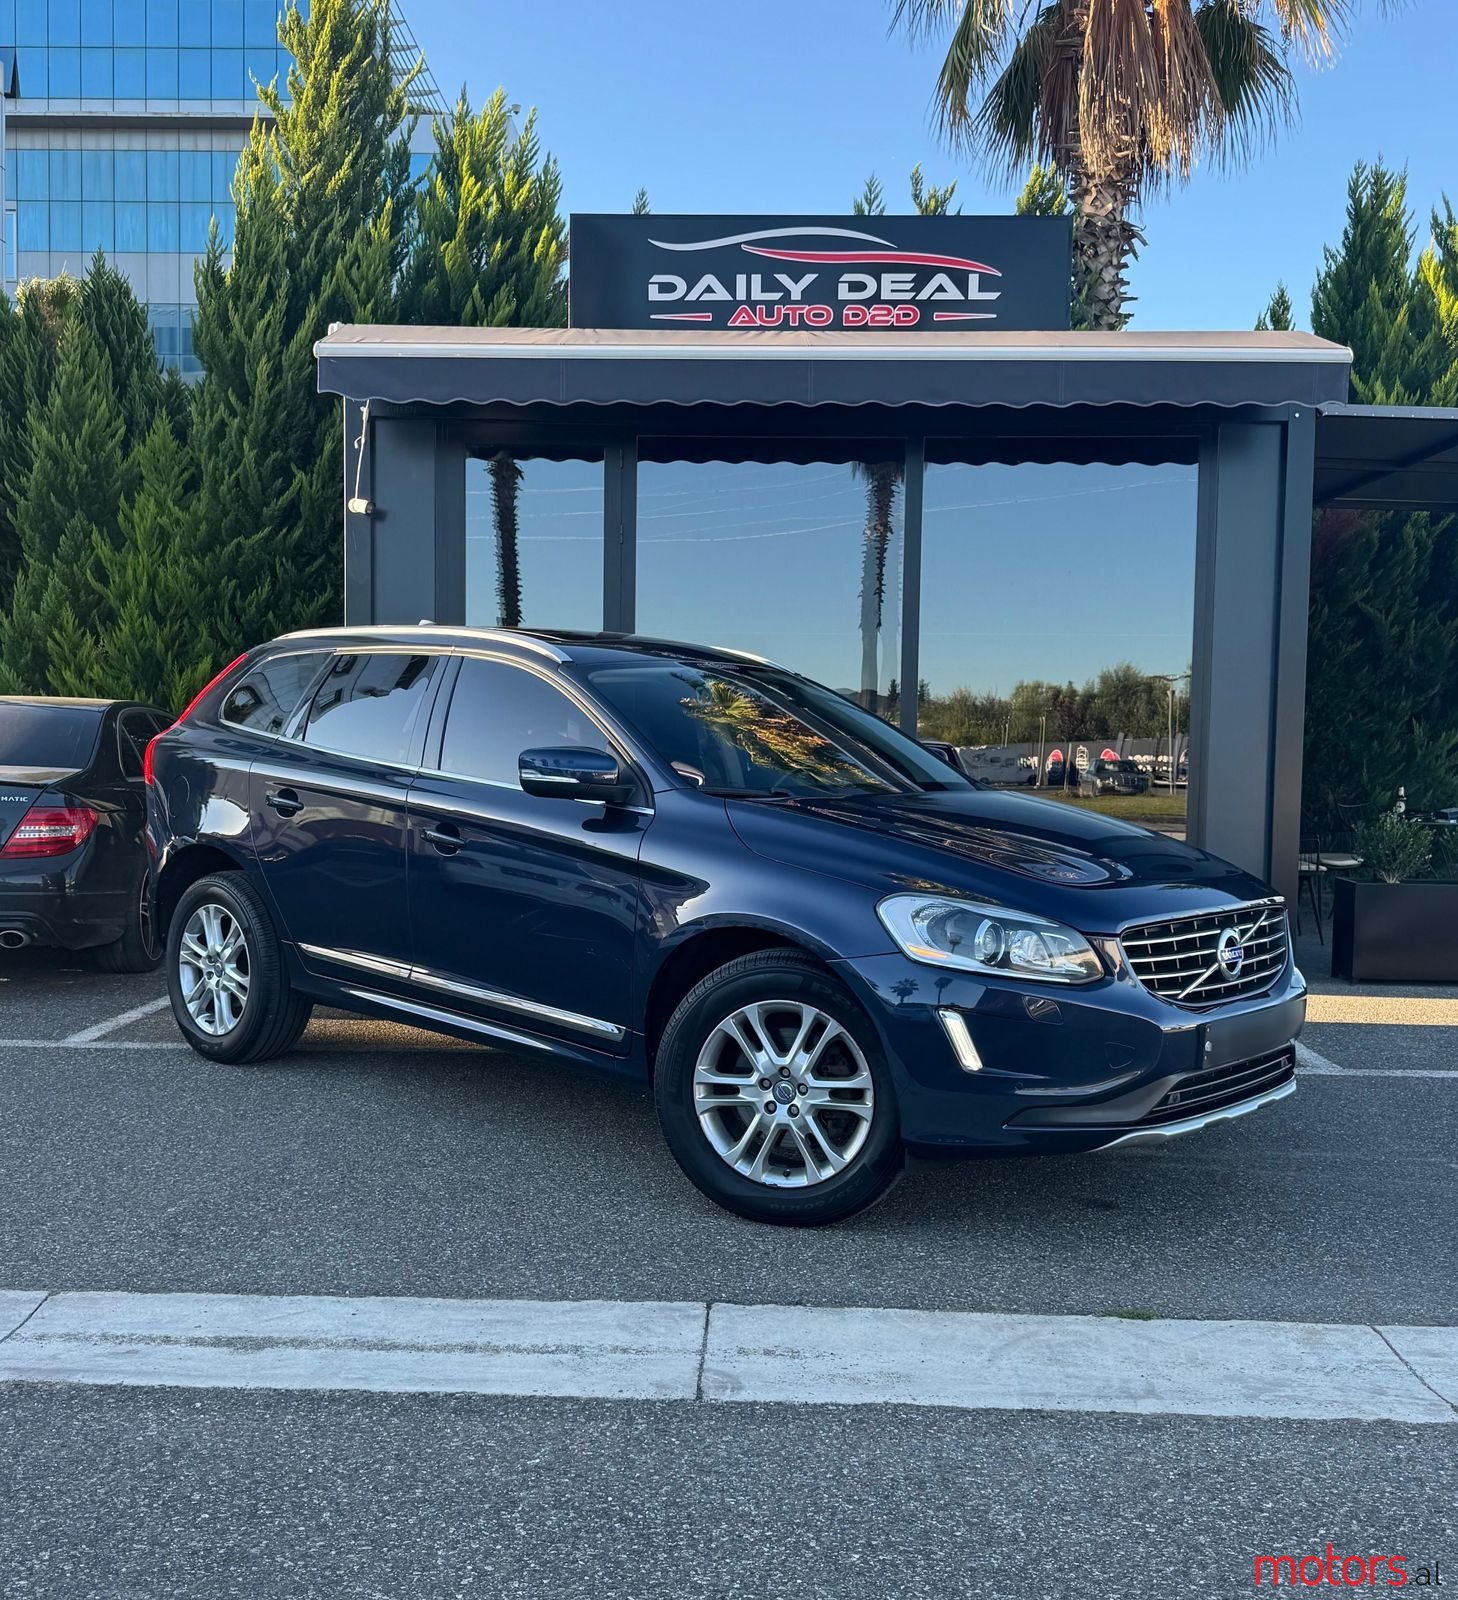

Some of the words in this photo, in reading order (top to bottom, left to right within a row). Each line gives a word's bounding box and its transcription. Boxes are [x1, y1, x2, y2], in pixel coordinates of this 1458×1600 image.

[648, 273, 819, 300] DAILY
[838, 273, 1002, 300] DEAL
[727, 304, 834, 327] AUTO
[842, 304, 921, 327] D2D
